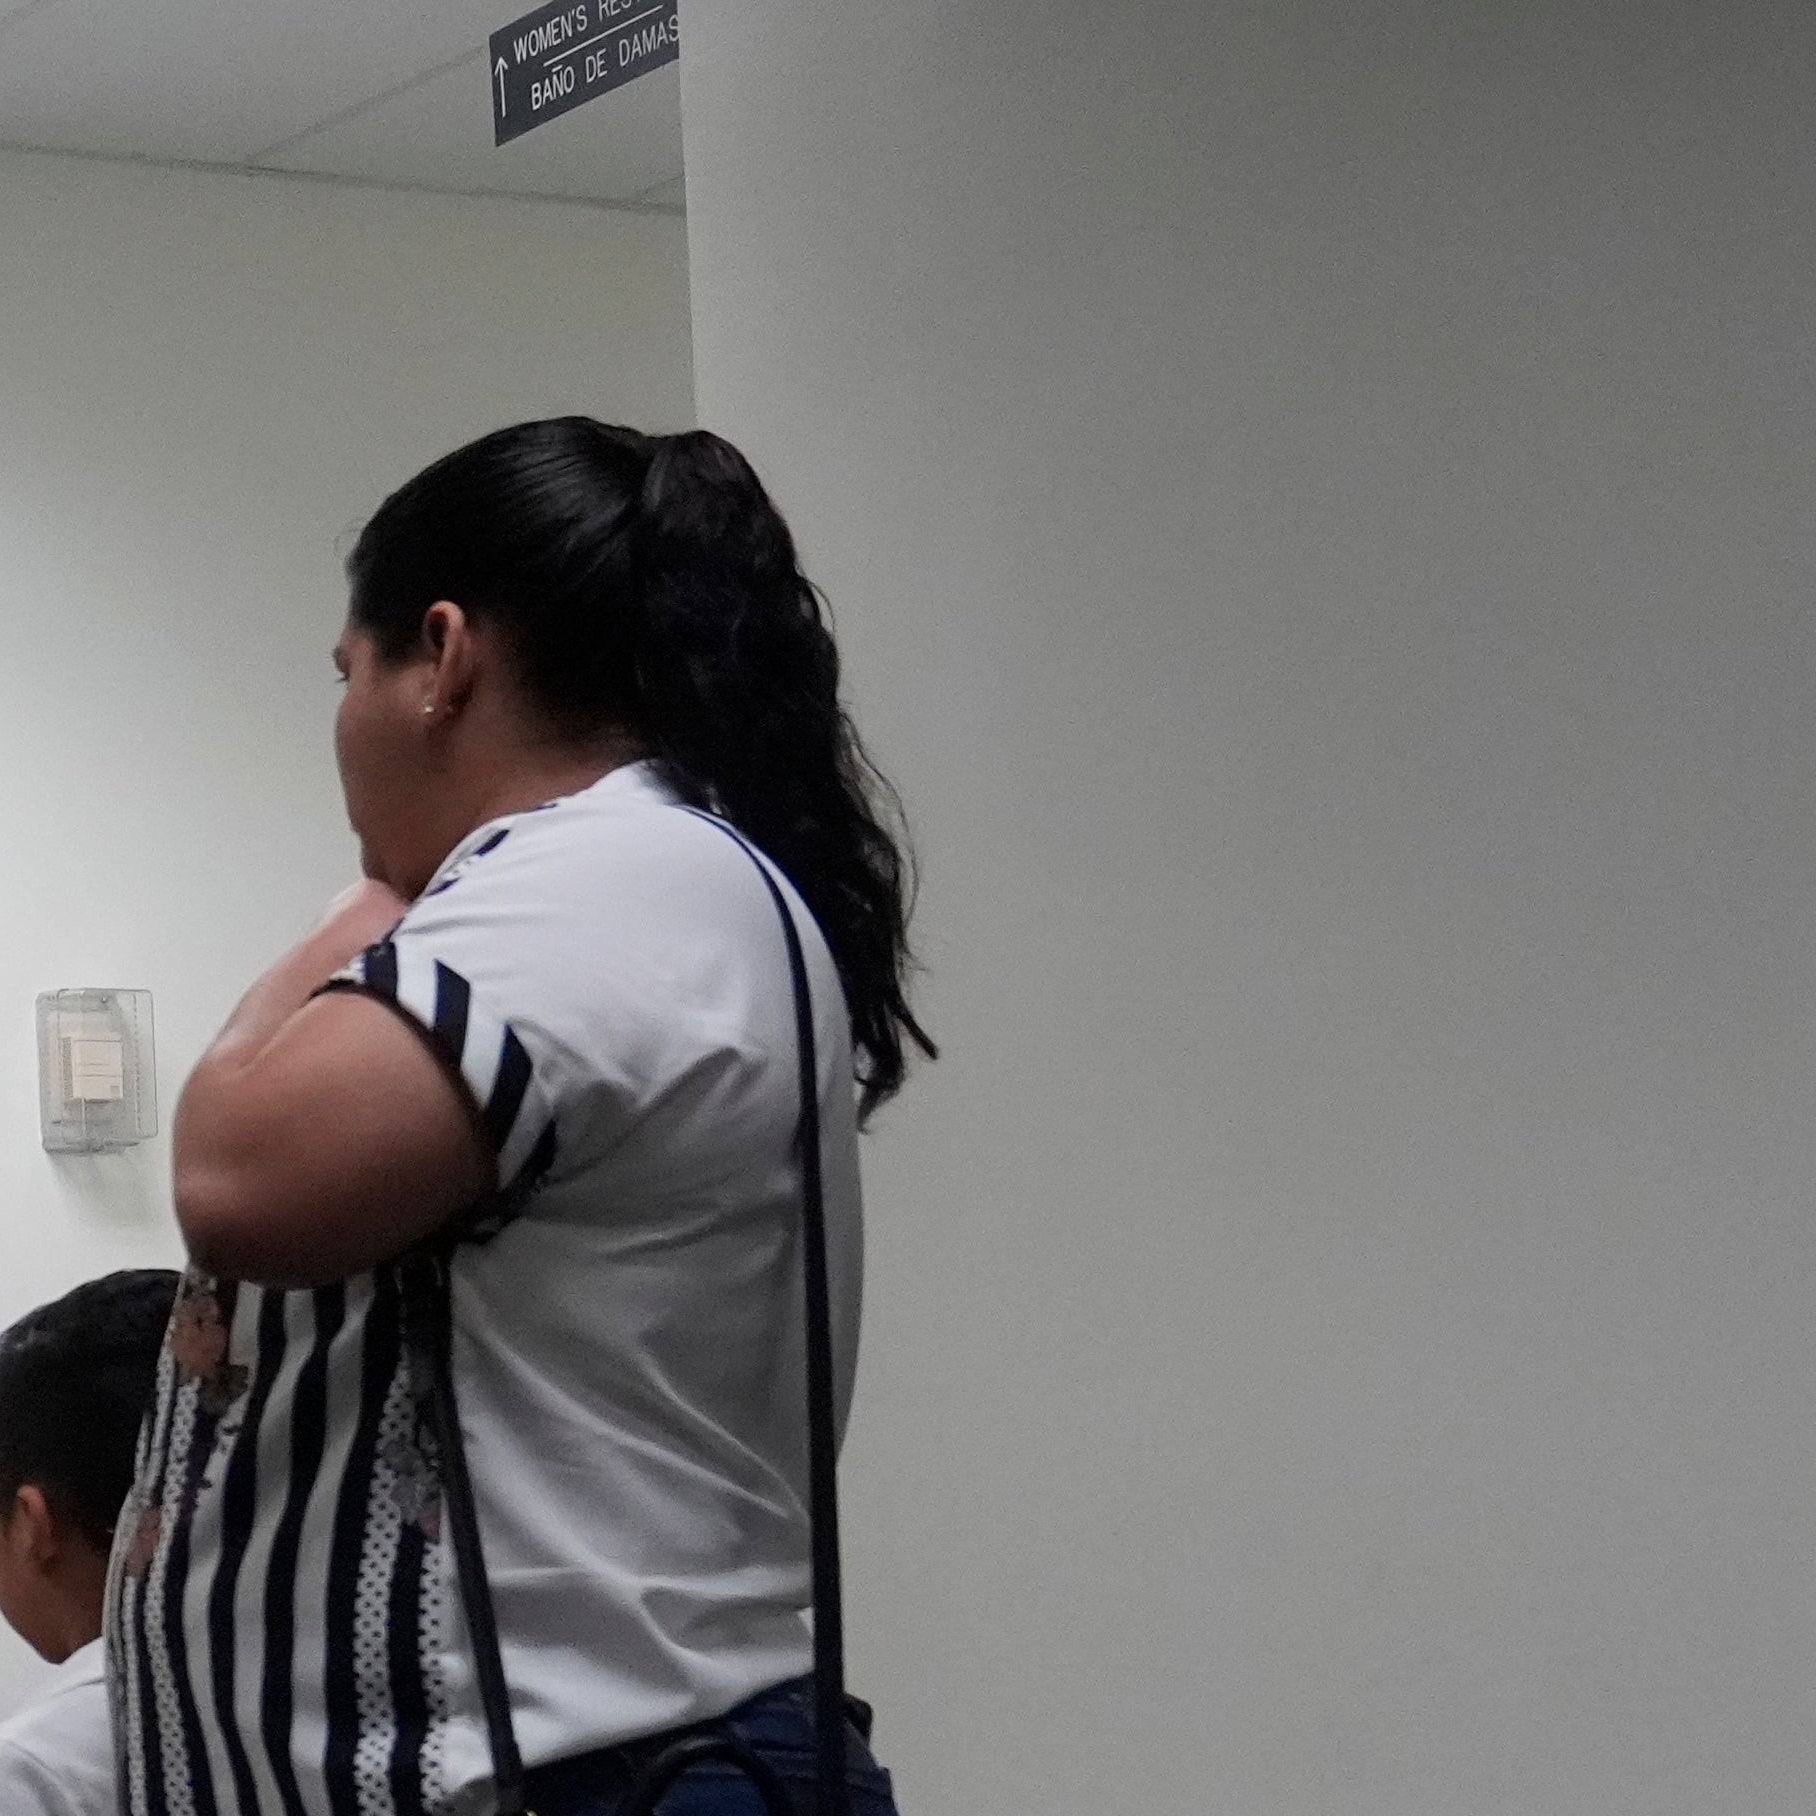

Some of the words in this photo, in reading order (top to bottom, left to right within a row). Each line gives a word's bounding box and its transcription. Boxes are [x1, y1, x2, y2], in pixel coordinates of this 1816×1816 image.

[513, 4, 588, 65] WOMEN'S
[530, 65, 575, 111] BAÑO
[585, 48, 607, 84] DE
[618, 14, 679, 67] DAMAS
